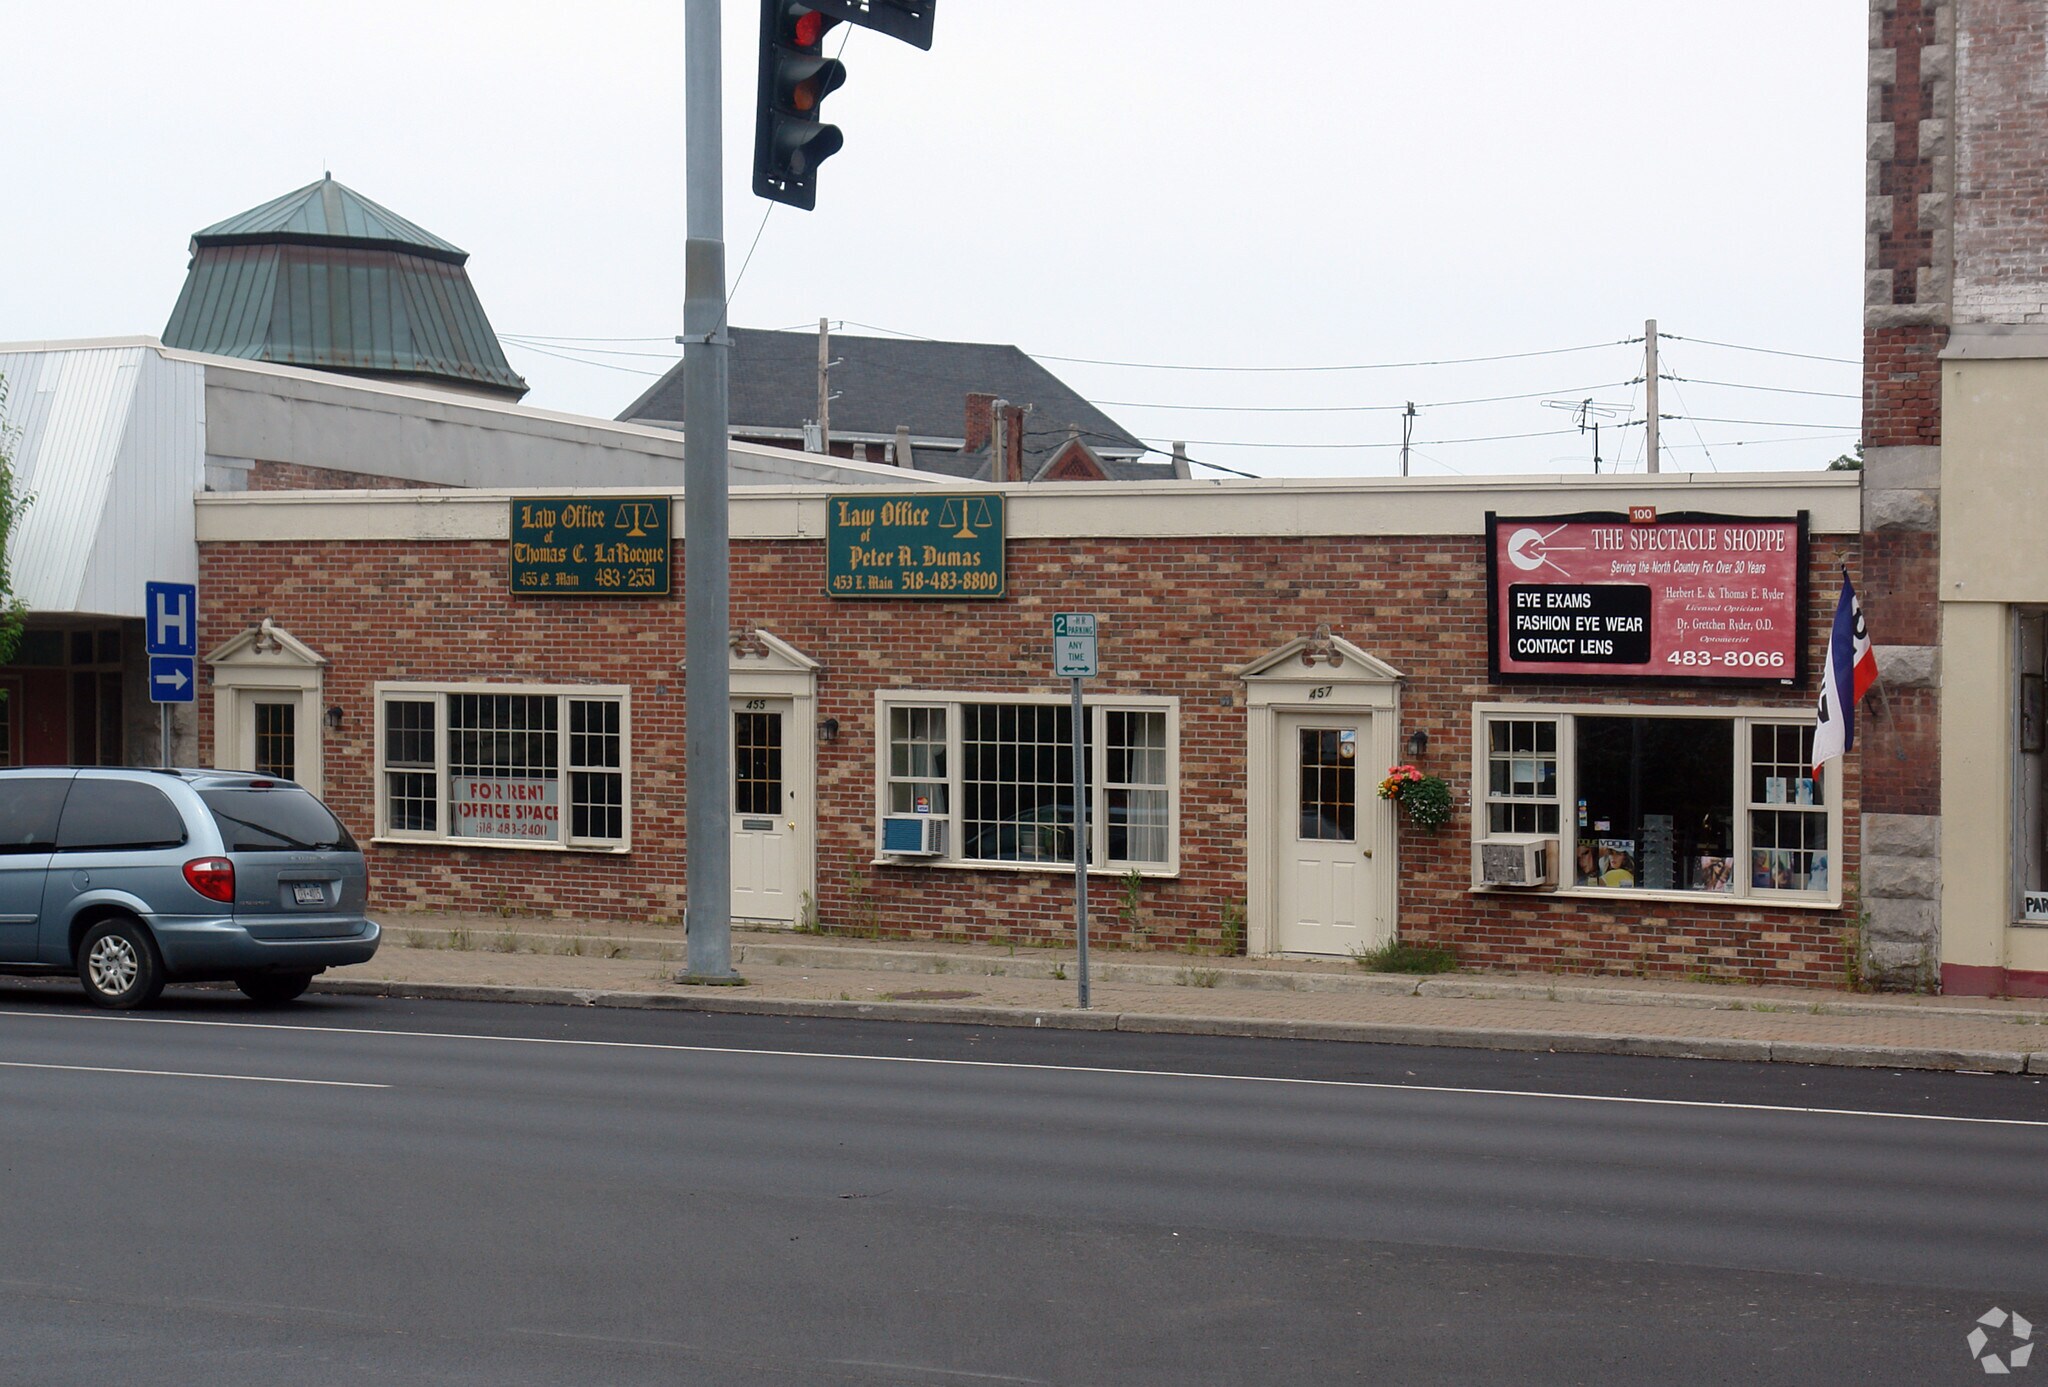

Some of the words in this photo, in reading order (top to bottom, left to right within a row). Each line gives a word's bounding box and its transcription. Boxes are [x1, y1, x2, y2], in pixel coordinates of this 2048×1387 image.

[522, 504, 556, 528] Law
[561, 504, 605, 528] Office
[838, 501, 875, 526] Law
[880, 501, 929, 526] Office
[1633, 509, 1652, 520] 100
[544, 530, 554, 544] of
[860, 528, 870, 542] of
[1592, 528, 1624, 550] THE
[1630, 528, 1717, 550] SPECTACLE
[1724, 529, 1786, 551] SHOPPE
[514, 542, 568, 564] Thomas
[572, 544, 587, 563] C.
[594, 542, 664, 566] LaRocque
[850, 546, 893, 571] Peter
[923, 546, 981, 566] Dumas
[1610, 560, 1636, 576] Serving
[1639, 561, 1650, 574] the
[1652, 560, 1671, 574] North
[1674, 560, 1700, 576] Country
[1702, 560, 1713, 574] For
[1716, 560, 1732, 574] Over
[1734, 561, 1744, 574] 30
[1747, 561, 1766, 574] Years
[520, 572, 537, 586] 455
[556, 572, 579, 586] Main
[594, 568, 655, 588] 483-2551
[833, 575, 852, 590] 453
[856, 575, 866, 590] E.
[868, 576, 893, 590] Main
[902, 571, 998, 590] 518-483-8800
[1517, 593, 1540, 608] EYE
[1547, 594, 1591, 608] EXAMS
[1666, 586, 1694, 598] Herbert
[1698, 587, 1705, 598] E.
[1708, 588, 1716, 598] &
[1720, 588, 1748, 599] Thomas
[1752, 588, 1759, 599] E.
[1762, 588, 1784, 601] Ryder
[157, 593, 187, 646] H
[1056, 617, 1066, 632] 2
[1517, 616, 1570, 630] FASHION
[1576, 616, 1600, 631] EYE
[1606, 617, 1642, 632] WEAR
[1677, 618, 1690, 630] Dr.
[1692, 618, 1726, 630] Gretchen
[1729, 619, 1752, 632] Ryder,
[1756, 619, 1774, 630] O.D.
[1068, 641, 1083, 650] ANY
[1518, 638, 1575, 654] CONTACT
[1580, 640, 1613, 654] LENS
[1068, 653, 1084, 662] TIME
[1667, 650, 1784, 667] 483-8066
[1308, 686, 1332, 699] 457
[746, 700, 766, 710] 455
[470, 783, 502, 800] FOR
[507, 784, 544, 800] RENT
[458, 802, 510, 819] OFFICE
